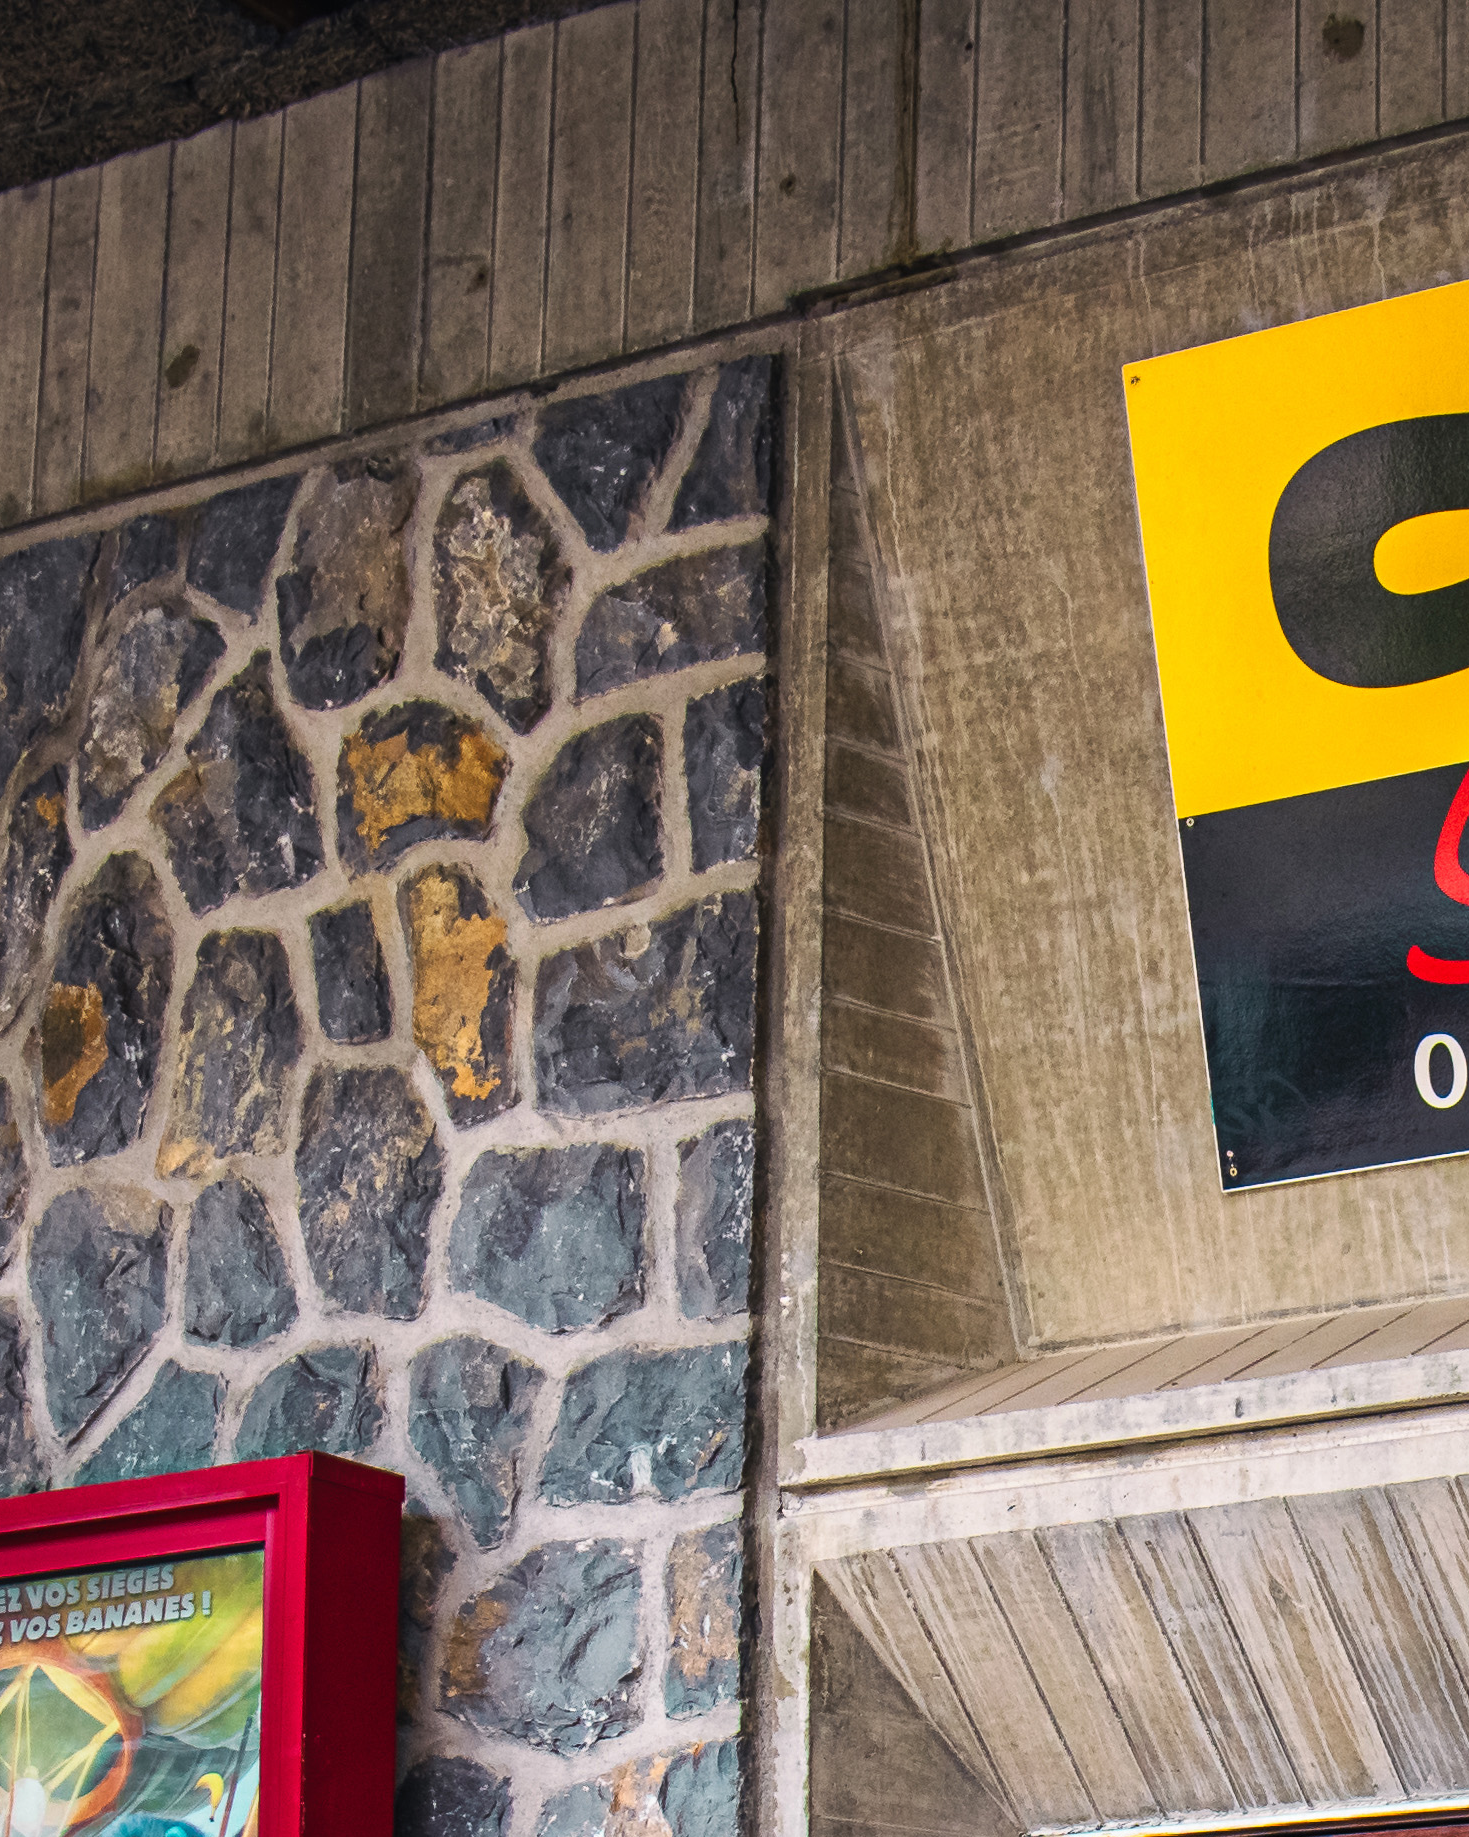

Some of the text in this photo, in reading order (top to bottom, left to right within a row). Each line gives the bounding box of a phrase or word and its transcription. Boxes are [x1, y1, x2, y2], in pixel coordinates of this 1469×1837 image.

[10, 1613, 62, 1643] VOS
[65, 1592, 196, 1636] BANANES
[201, 1589, 212, 1616] !
[26, 1580, 82, 1611] VOS
